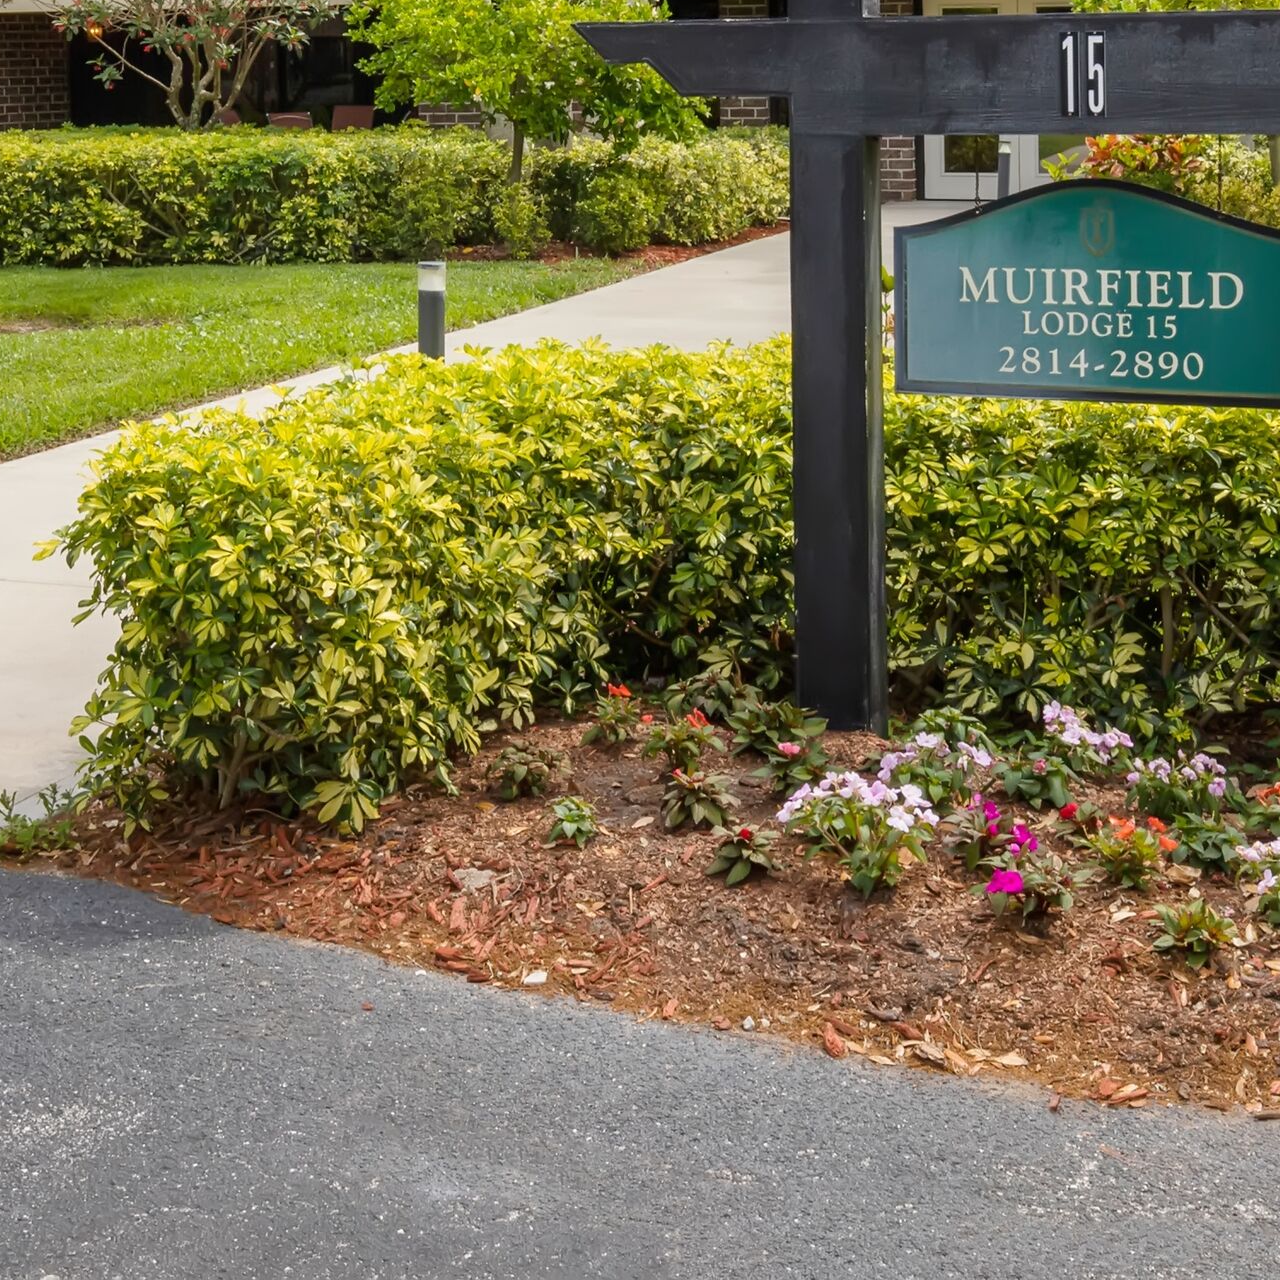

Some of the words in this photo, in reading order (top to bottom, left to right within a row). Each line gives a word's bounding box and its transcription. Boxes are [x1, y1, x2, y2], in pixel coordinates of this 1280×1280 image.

[1061, 35, 1105, 114] 15
[958, 266, 1245, 310] MUIRFIELD
[1022, 311, 1133, 338] LODGE
[1147, 315, 1178, 340] 15
[998, 346, 1205, 380] 2814-2890
